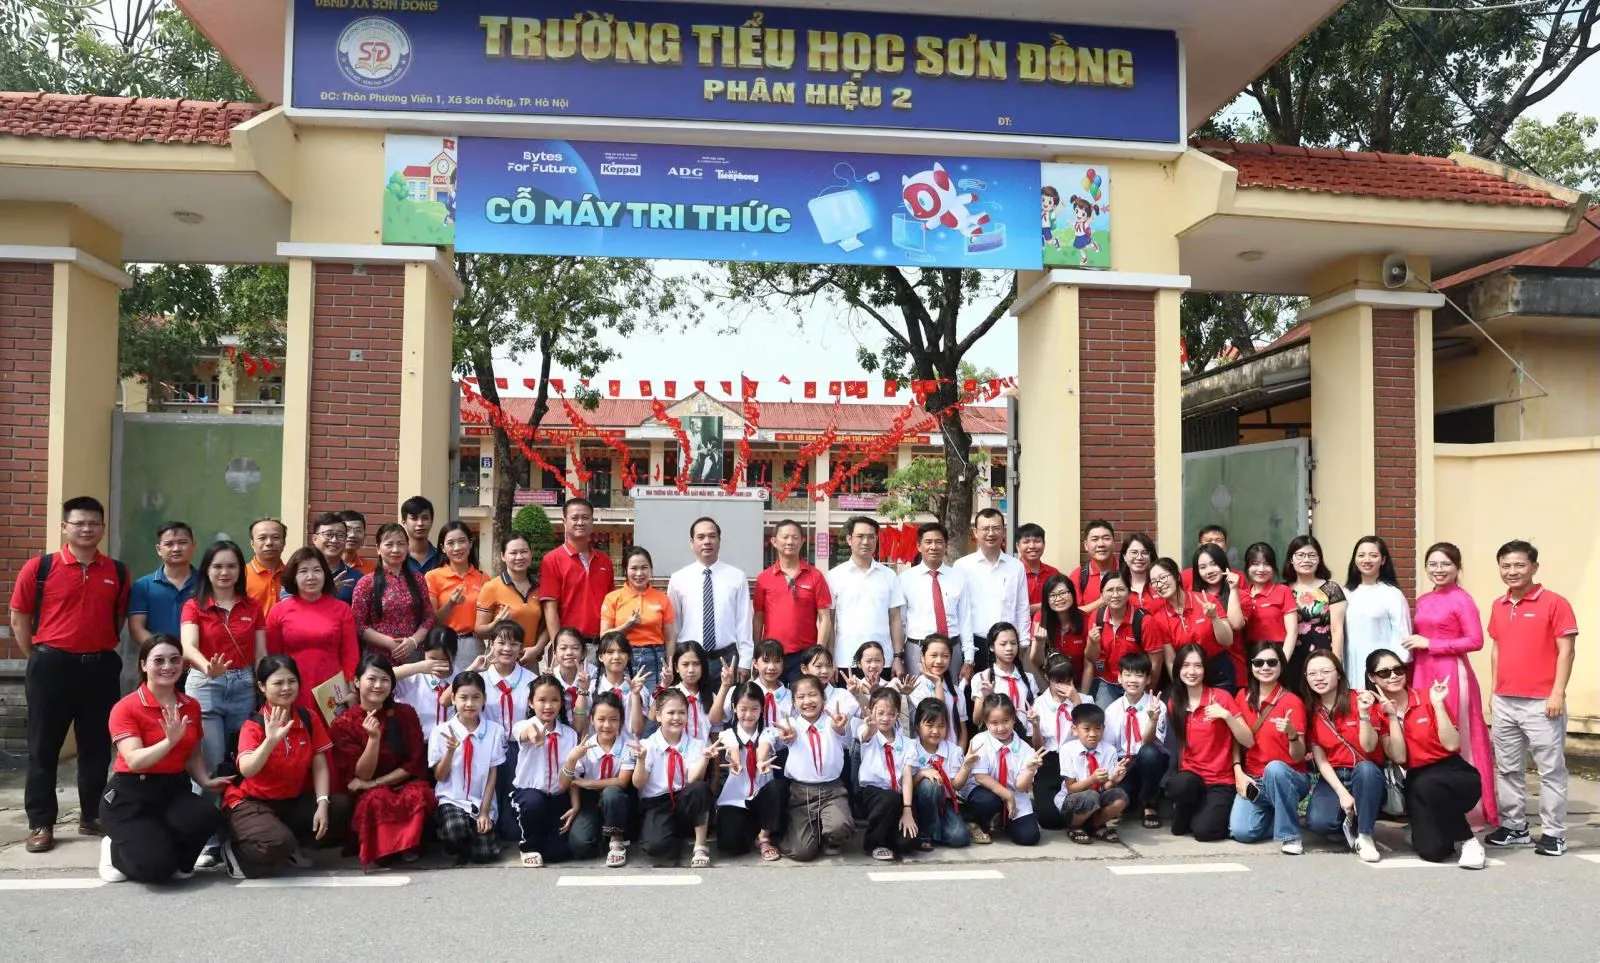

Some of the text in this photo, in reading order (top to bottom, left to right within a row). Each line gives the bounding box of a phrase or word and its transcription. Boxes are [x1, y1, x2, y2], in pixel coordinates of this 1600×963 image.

[479, 9, 1135, 88] TRƯỜNG TIỂU HỌC SƠN ĐỒNG
[342, 92, 367, 102] Thôn
[410, 94, 433, 104] Viên
[519, 98, 532, 108] TP.
[535, 98, 550, 108] Hà
[552, 99, 569, 110] Nội
[703, 77, 914, 111] PHÂN HIỆU 2
[523, 151, 563, 163] Bytes
[507, 162, 577, 174] For Future
[602, 163, 639, 175] Keppel
[667, 166, 703, 176] ADG
[485, 186, 792, 233] CỖ MÁY TRI THỨC
